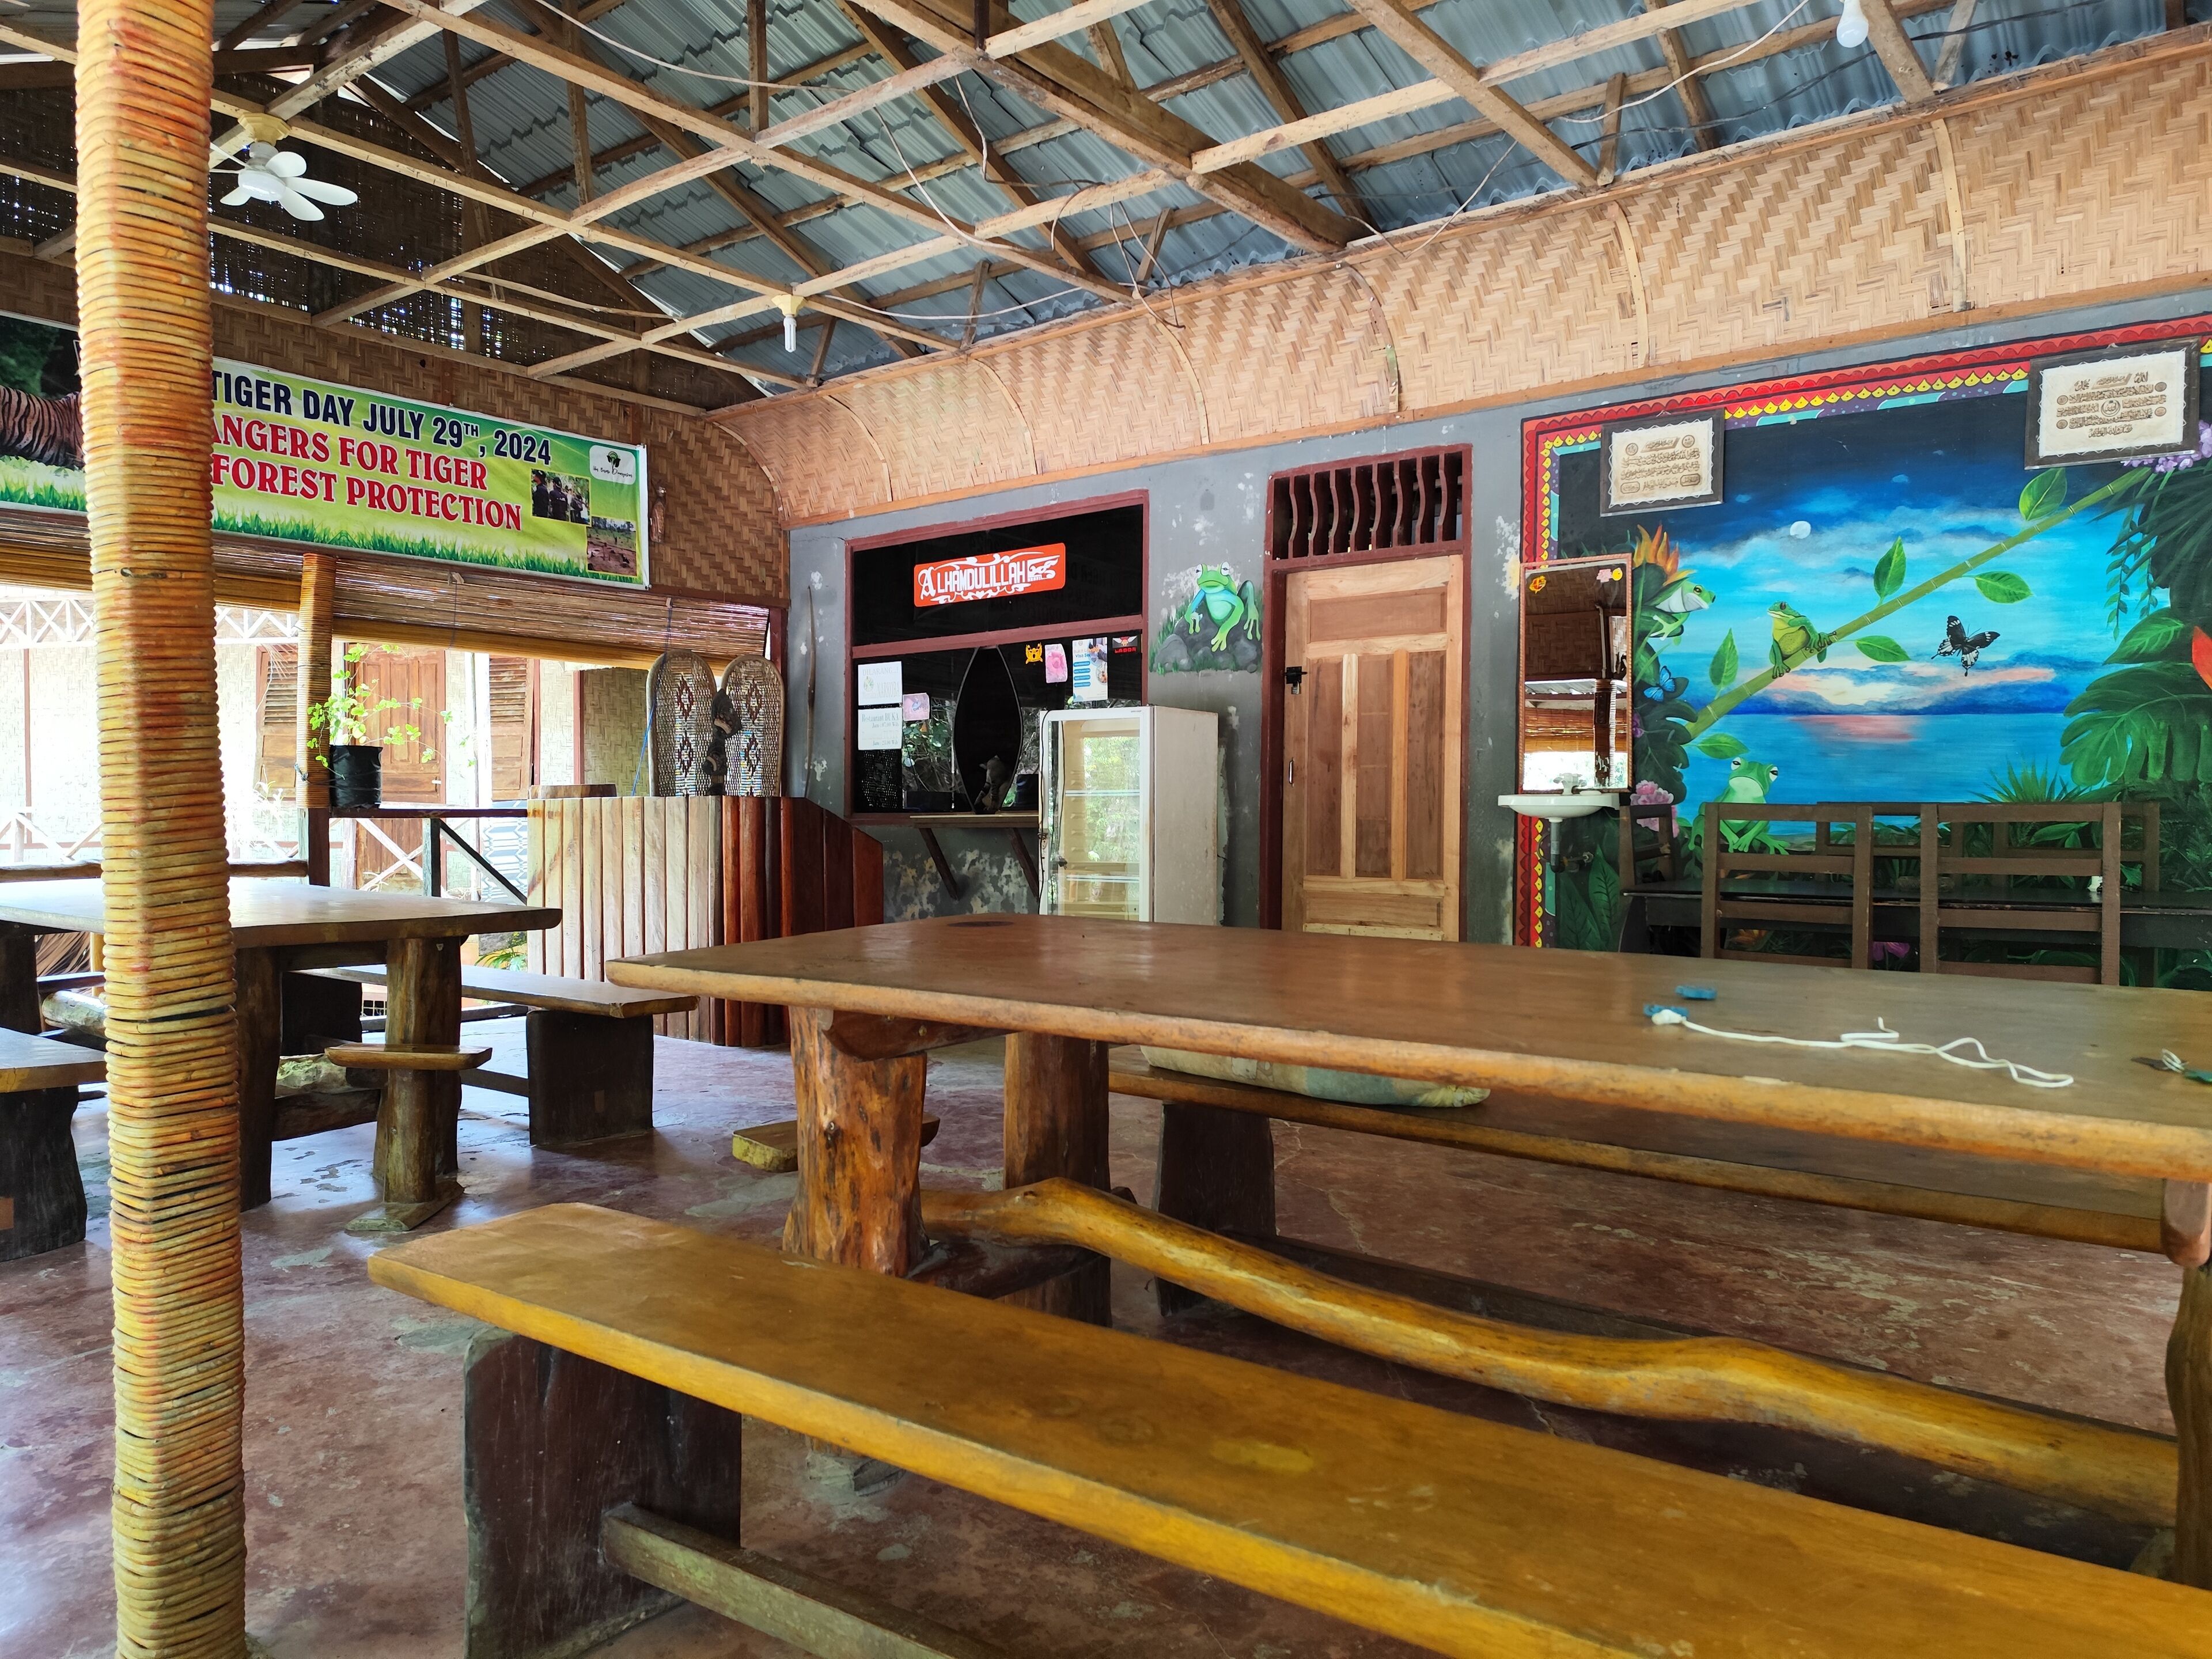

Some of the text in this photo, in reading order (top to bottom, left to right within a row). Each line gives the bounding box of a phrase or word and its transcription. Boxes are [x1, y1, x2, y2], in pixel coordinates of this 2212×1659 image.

[213, 370, 293, 416] TIGER
[303, 389, 355, 427] DAY
[363, 403, 425, 440] JULY
[494, 430, 551, 465] 2024
[212, 453, 522, 531] FOREST PROTECTION
[339, 437, 399, 475] FOR
[406, 448, 488, 491] TIGER
[885, 712, 899, 721] BUKA
